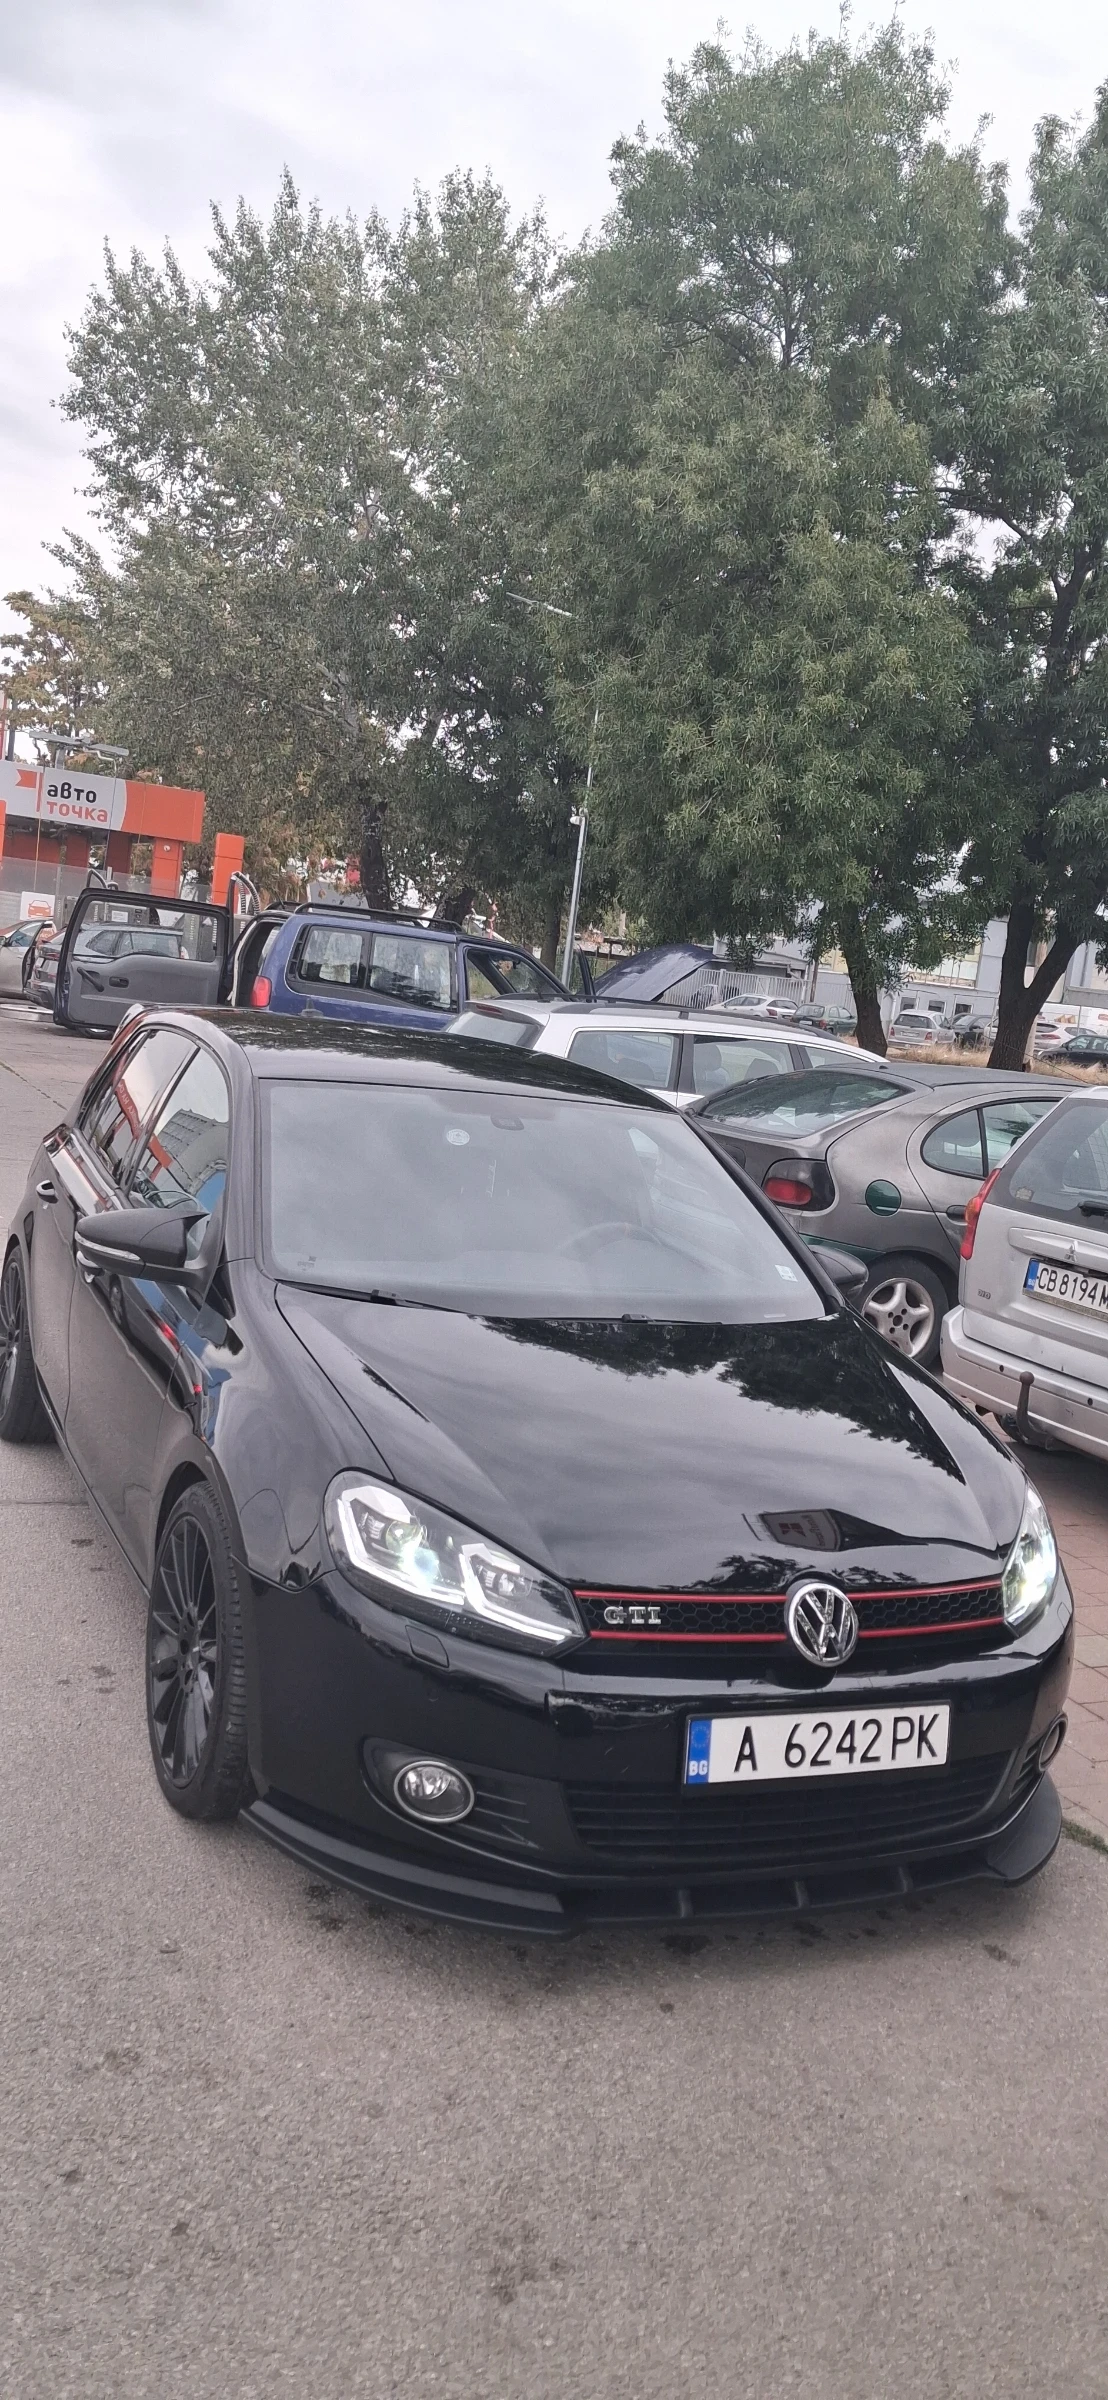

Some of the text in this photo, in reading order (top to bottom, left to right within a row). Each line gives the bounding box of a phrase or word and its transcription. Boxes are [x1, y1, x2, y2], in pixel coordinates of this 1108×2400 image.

[47, 782, 97, 803] авто
[47, 801, 108, 823] точка
[603, 1606, 662, 1625] GTI
[688, 1760, 708, 1776] BG
